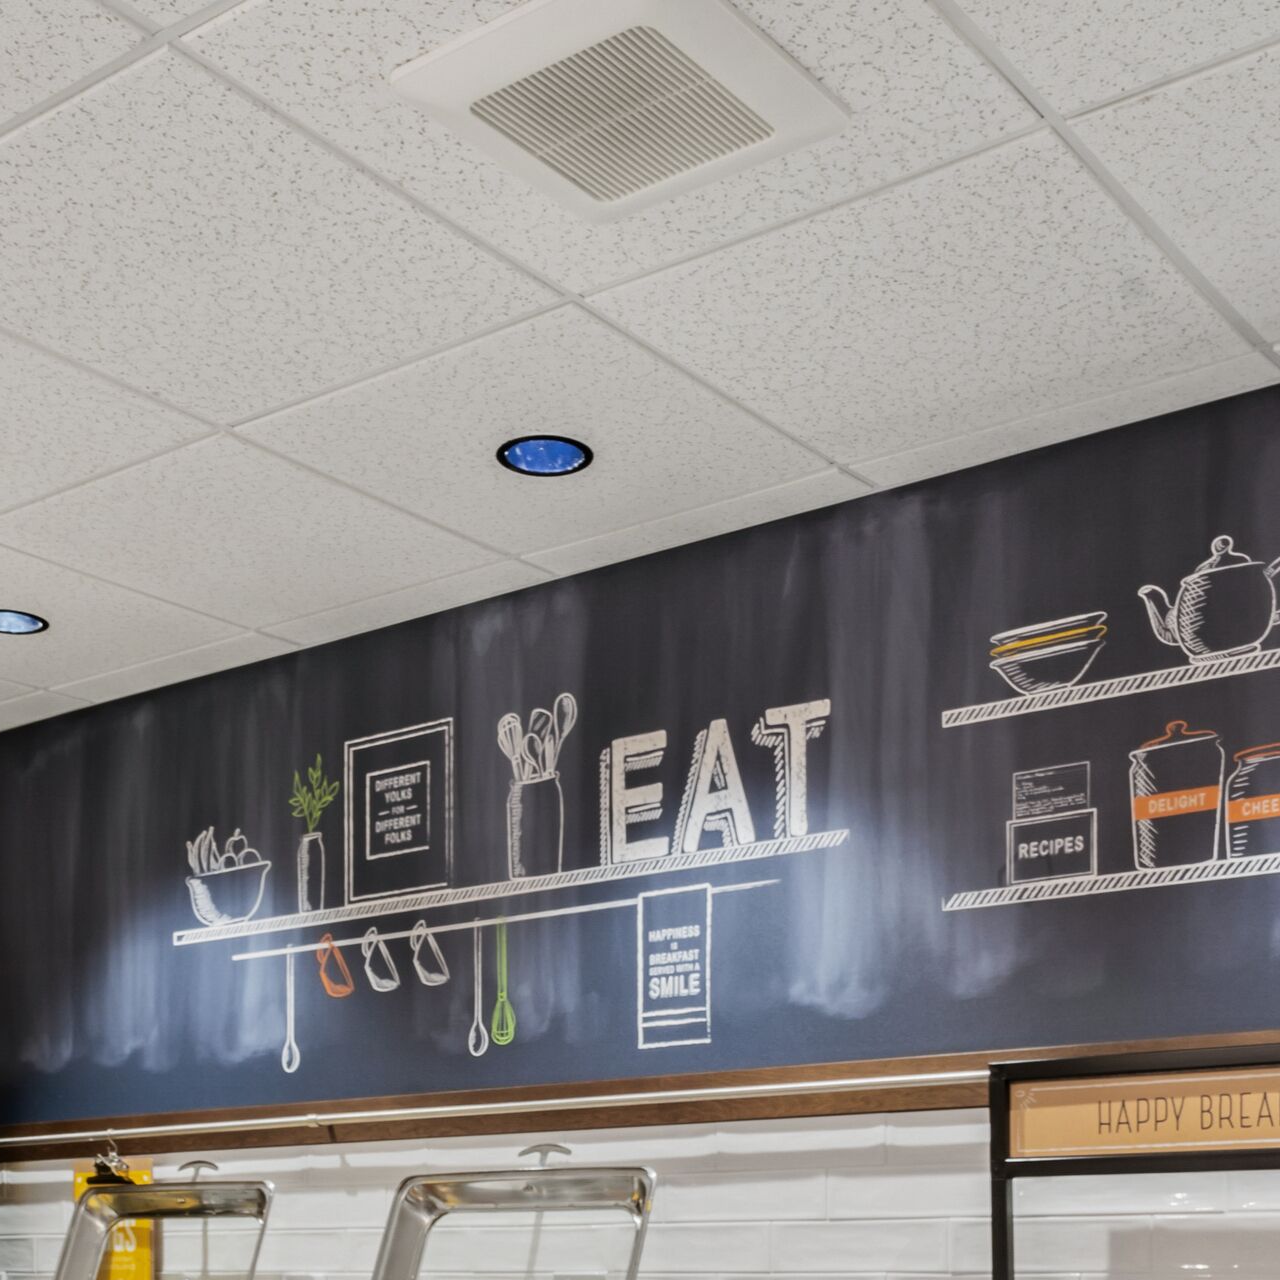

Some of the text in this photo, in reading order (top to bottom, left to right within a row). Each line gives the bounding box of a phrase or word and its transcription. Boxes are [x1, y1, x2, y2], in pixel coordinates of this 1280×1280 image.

[375, 772, 422, 792] DIFFERENT
[600, 699, 831, 866] EAT
[384, 787, 413, 803] YOLKS
[1148, 793, 1206, 814] DELIGHT
[391, 805, 406, 816] FOR
[375, 814, 422, 833] DIFFERENT
[384, 829, 413, 844] FOLKS
[1018, 835, 1084, 859] RECIPES
[648, 925, 700, 942] HAPPINESS
[648, 948, 700, 966] BREAKFAST
[694, 962, 700, 971] A
[648, 972, 701, 1000] SMILE
[1098, 1096, 1185, 1134] HAPPY
